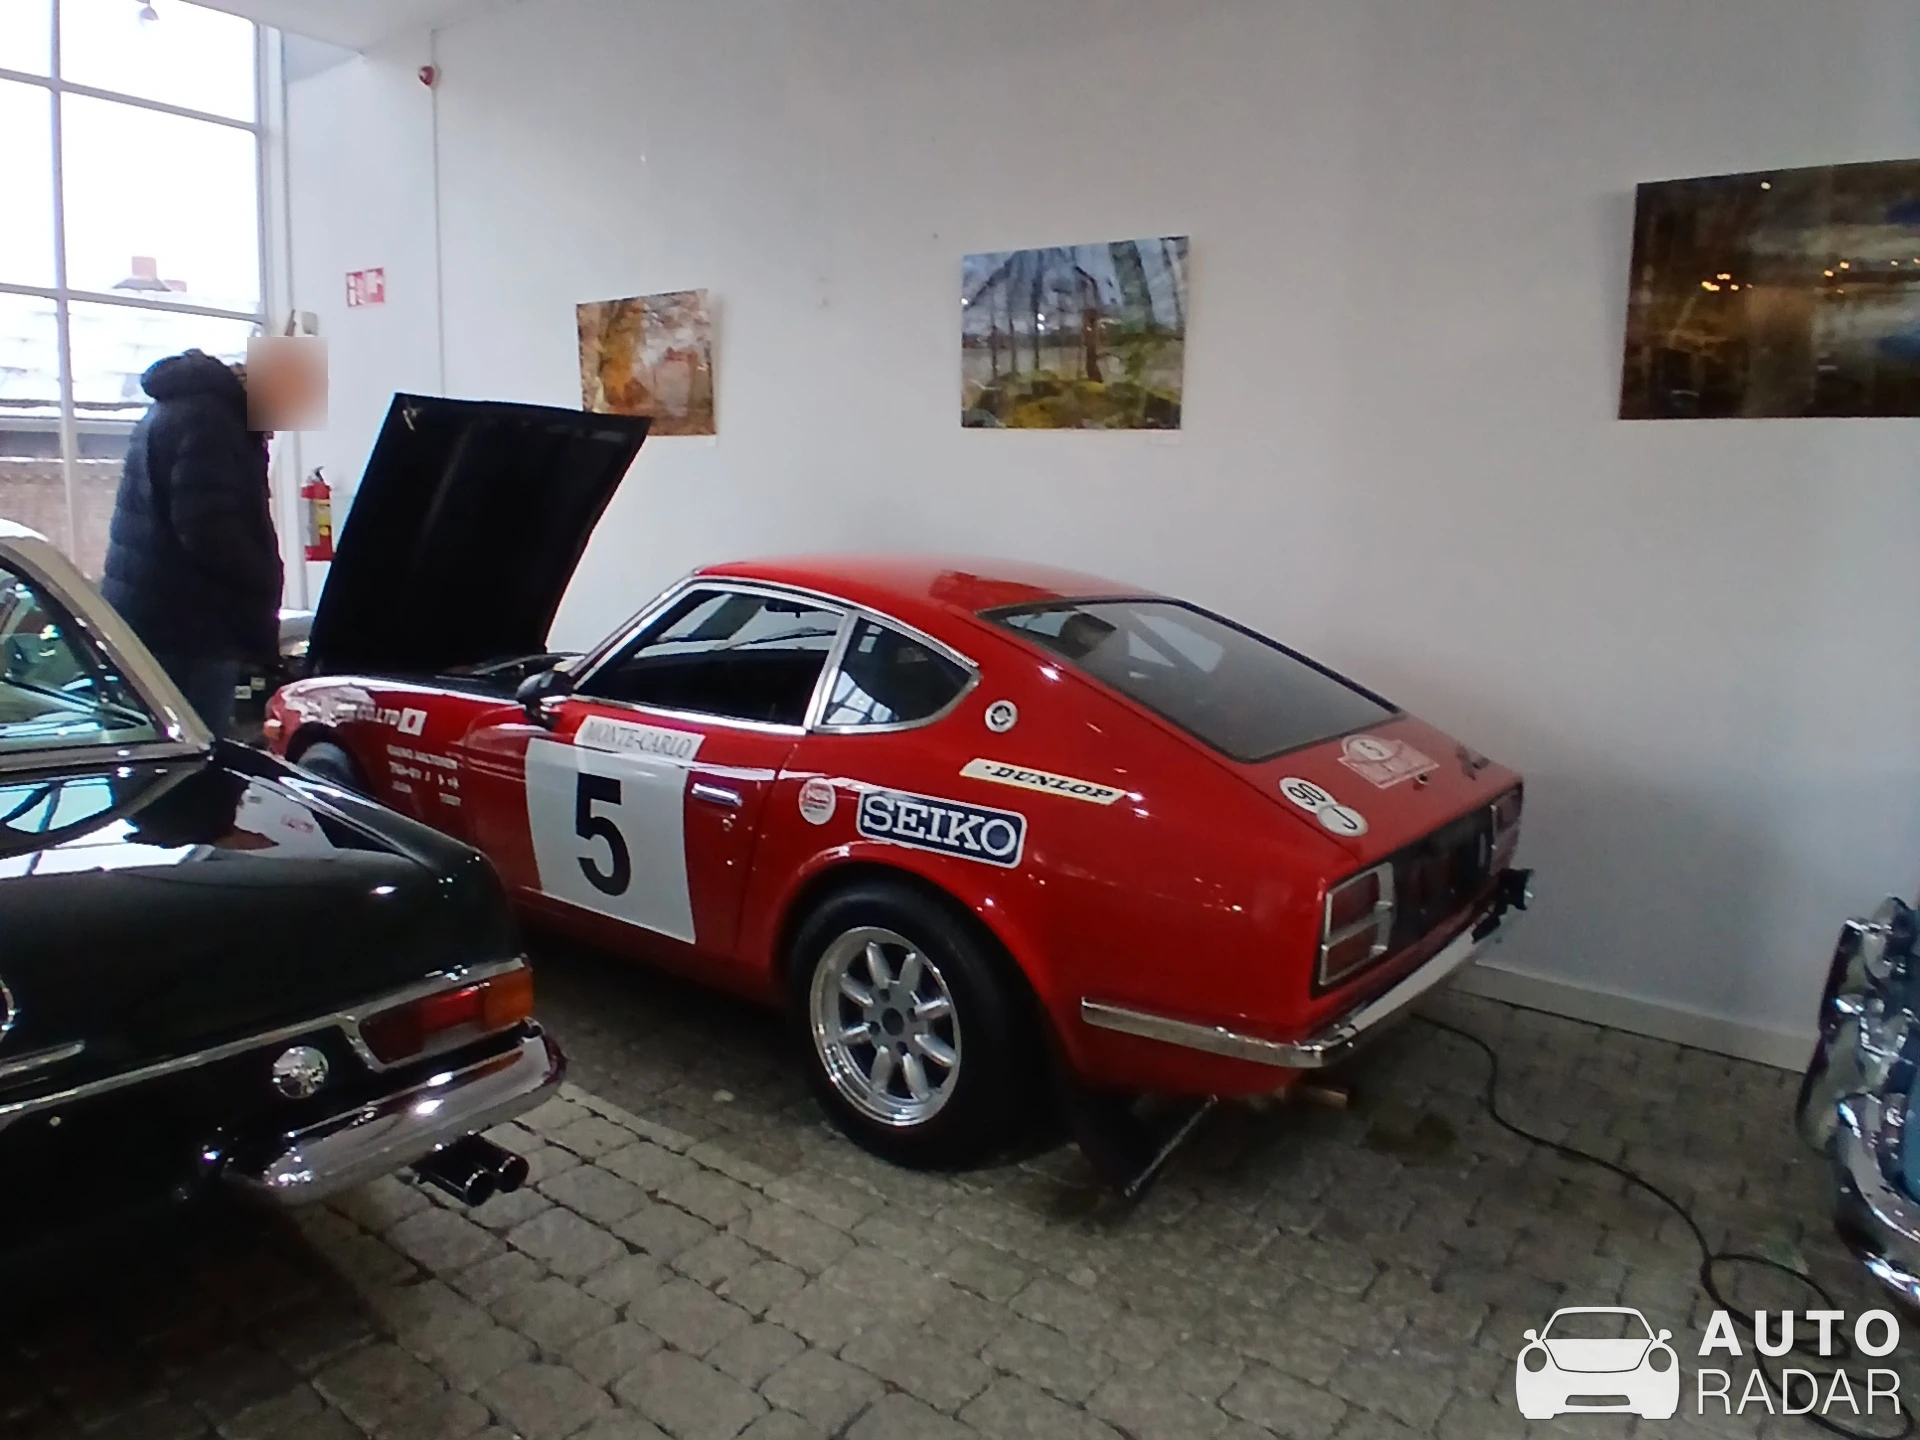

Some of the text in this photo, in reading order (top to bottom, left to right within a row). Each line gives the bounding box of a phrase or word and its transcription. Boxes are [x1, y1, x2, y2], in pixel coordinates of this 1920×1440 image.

[584, 720, 693, 758] MONTE-CARLO
[1360, 741, 1385, 757] 5
[990, 765, 1114, 799] DUNLOP
[1287, 782, 1326, 807] 90
[575, 771, 631, 897] 5
[862, 794, 1017, 857] SEIKO
